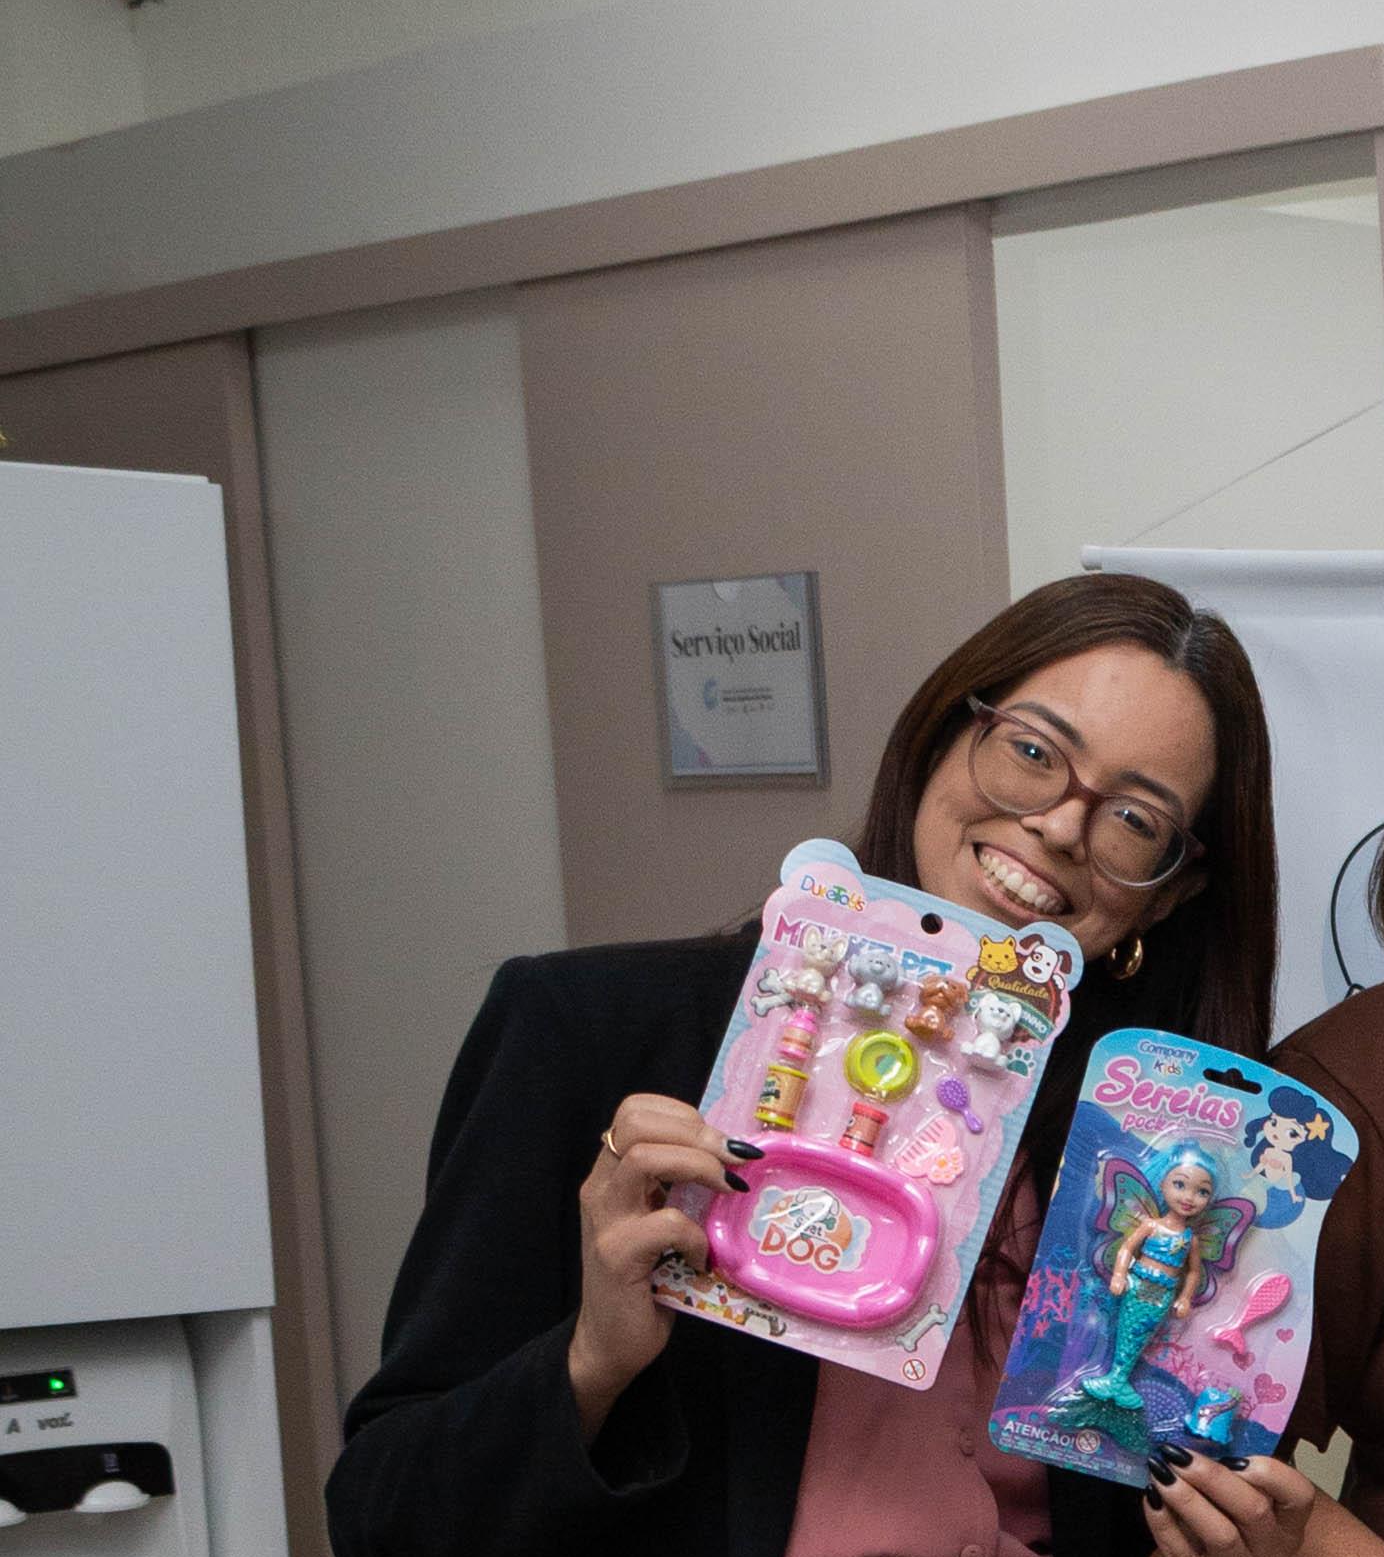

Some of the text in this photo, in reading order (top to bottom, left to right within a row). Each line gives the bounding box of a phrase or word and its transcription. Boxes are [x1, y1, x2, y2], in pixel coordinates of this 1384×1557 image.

[671, 620, 801, 663] Serviço Social
[1138, 1040, 1199, 1064] Company
[1094, 1057, 1241, 1128] Sereias
[759, 1222, 842, 1272] DOG
